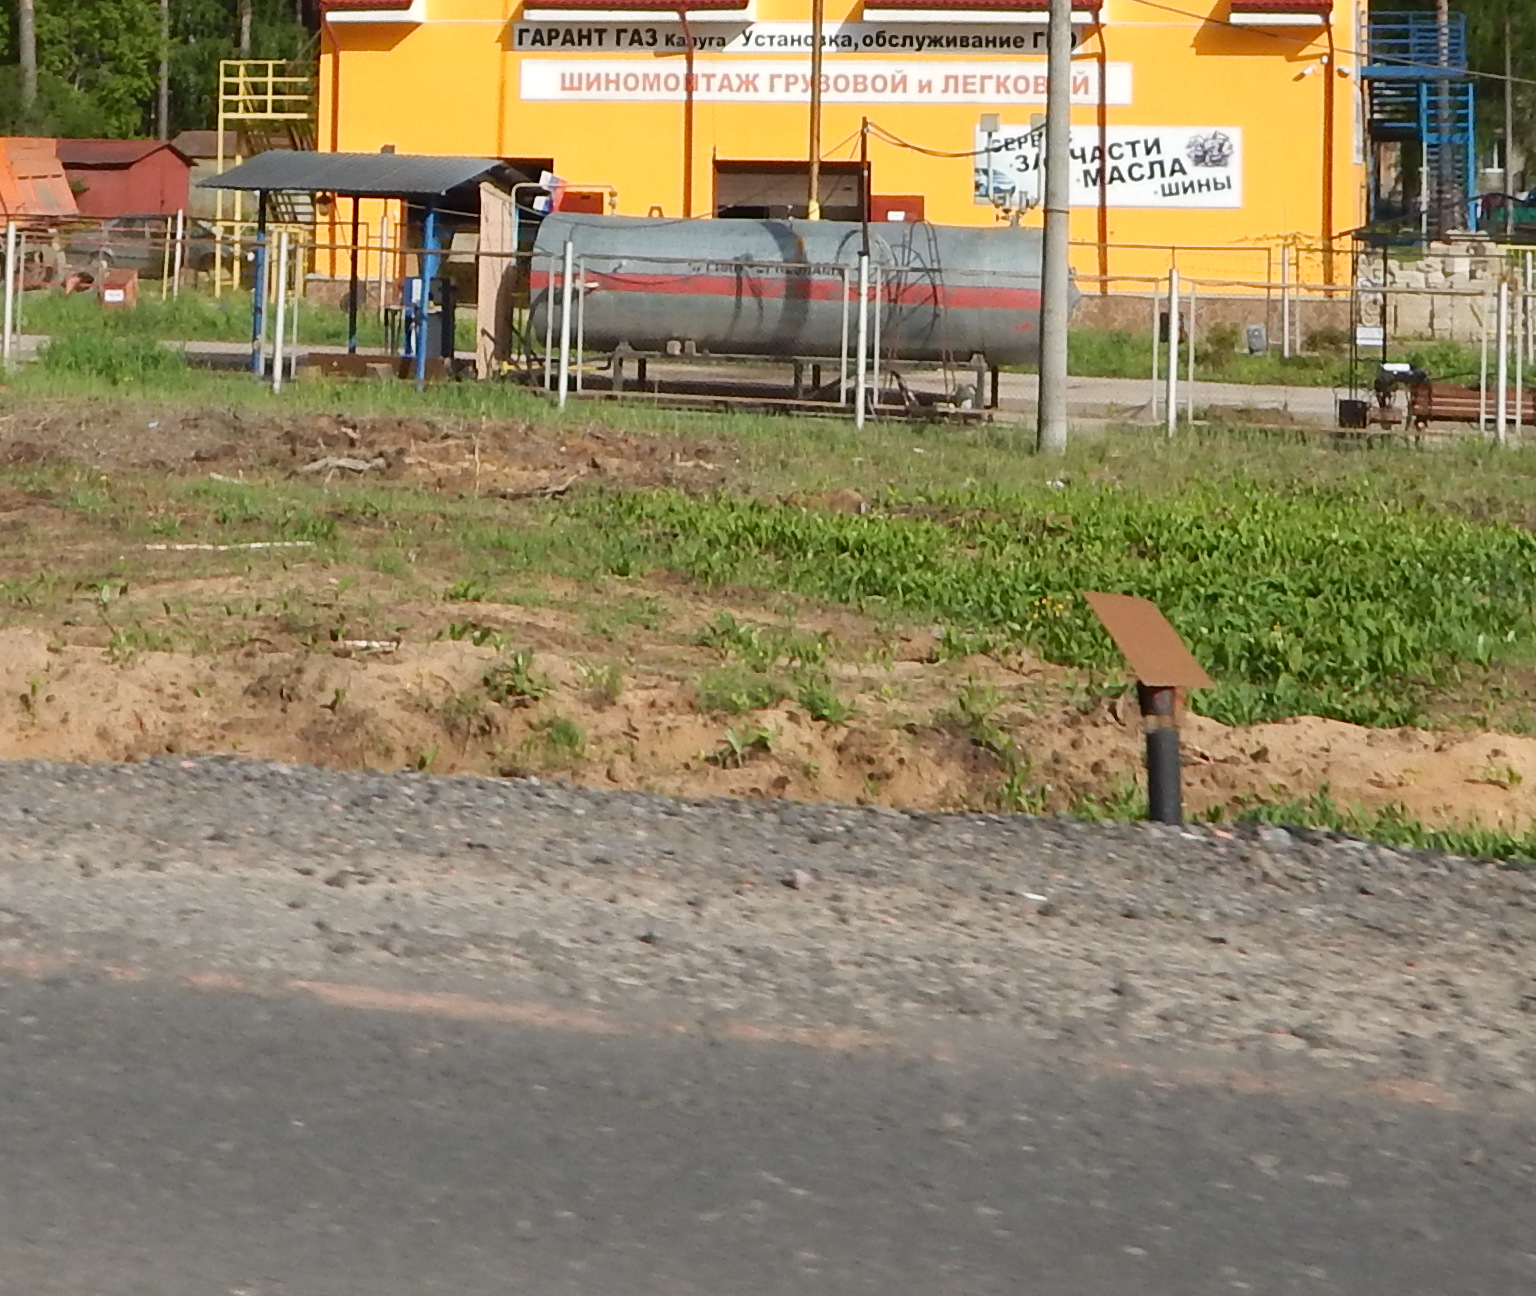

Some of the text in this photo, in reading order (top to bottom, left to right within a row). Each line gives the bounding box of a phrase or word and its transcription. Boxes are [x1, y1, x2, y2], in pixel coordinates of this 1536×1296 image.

[517, 28, 608, 47] ГАРАНТ
[615, 27, 658, 47] ГАЗ
[559, 69, 1090, 95] ШИНОМОНТАЖ ГРУЗОВОЙ и ЛЕГКОВЙ
[991, 128, 1073, 153] СЕРВ
[1014, 137, 1162, 173] ЗЧАСТИ
[1082, 158, 1188, 188] МАСЛА
[1160, 175, 1233, 197] ШИНЫ
